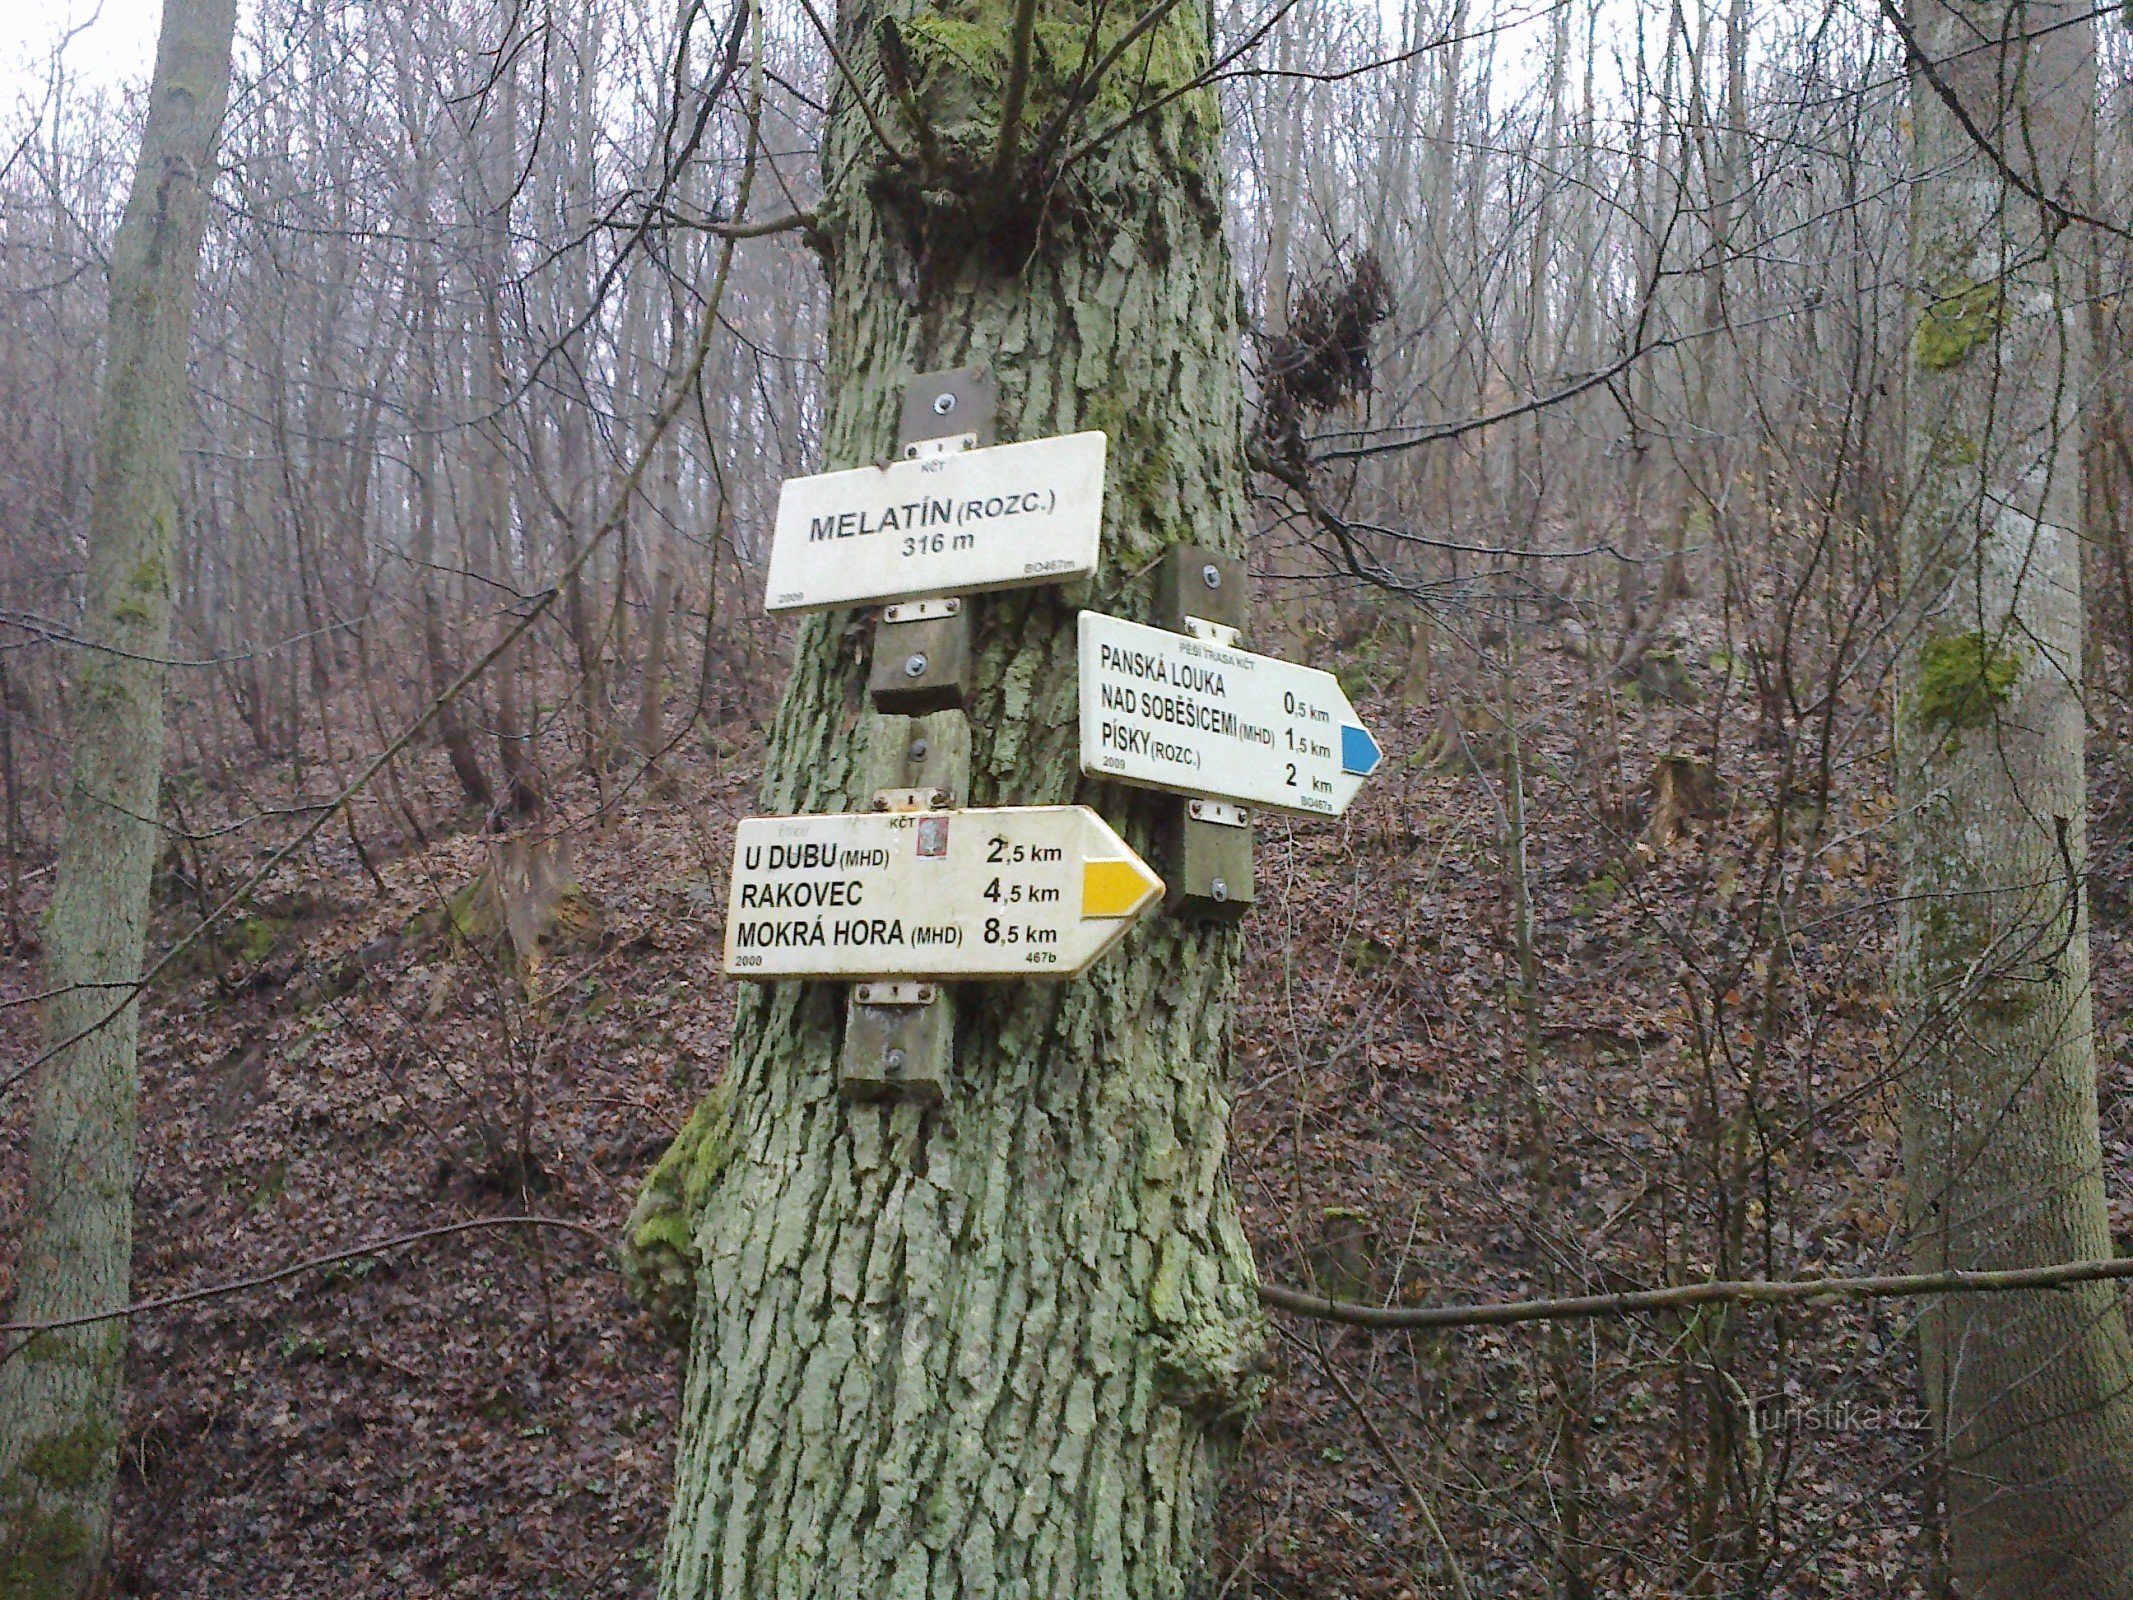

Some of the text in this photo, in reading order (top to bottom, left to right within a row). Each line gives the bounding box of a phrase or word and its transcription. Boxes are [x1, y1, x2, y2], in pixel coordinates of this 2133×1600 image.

[809, 489, 1056, 542] MELATÍN (ROZC.)
[902, 533, 975, 557] 316 m
[1101, 644, 1226, 698] PANSKÁ LOUKA
[1101, 683, 1276, 750] NAD SOBĚŠICEMI (MHD)
[1284, 691, 1330, 724] 0,5 km
[1102, 718, 1201, 770] PÍSKY (ROZC.)
[1285, 727, 1331, 758] 1,5 km
[1103, 755, 1125, 770] 2009
[1286, 763, 1333, 794] 2 km
[889, 816, 916, 829] KČT
[745, 843, 890, 871] U DUBU (MHD)
[986, 837, 1062, 866] 2,5 km
[741, 880, 863, 907] RAKOVEC
[983, 877, 1060, 906] 4,5 km
[737, 914, 964, 949] MOKRÁ HORA (MHD)
[983, 917, 1058, 947] 8,5 km
[735, 955, 763, 967] 2000
[1025, 951, 1058, 963] 467b
